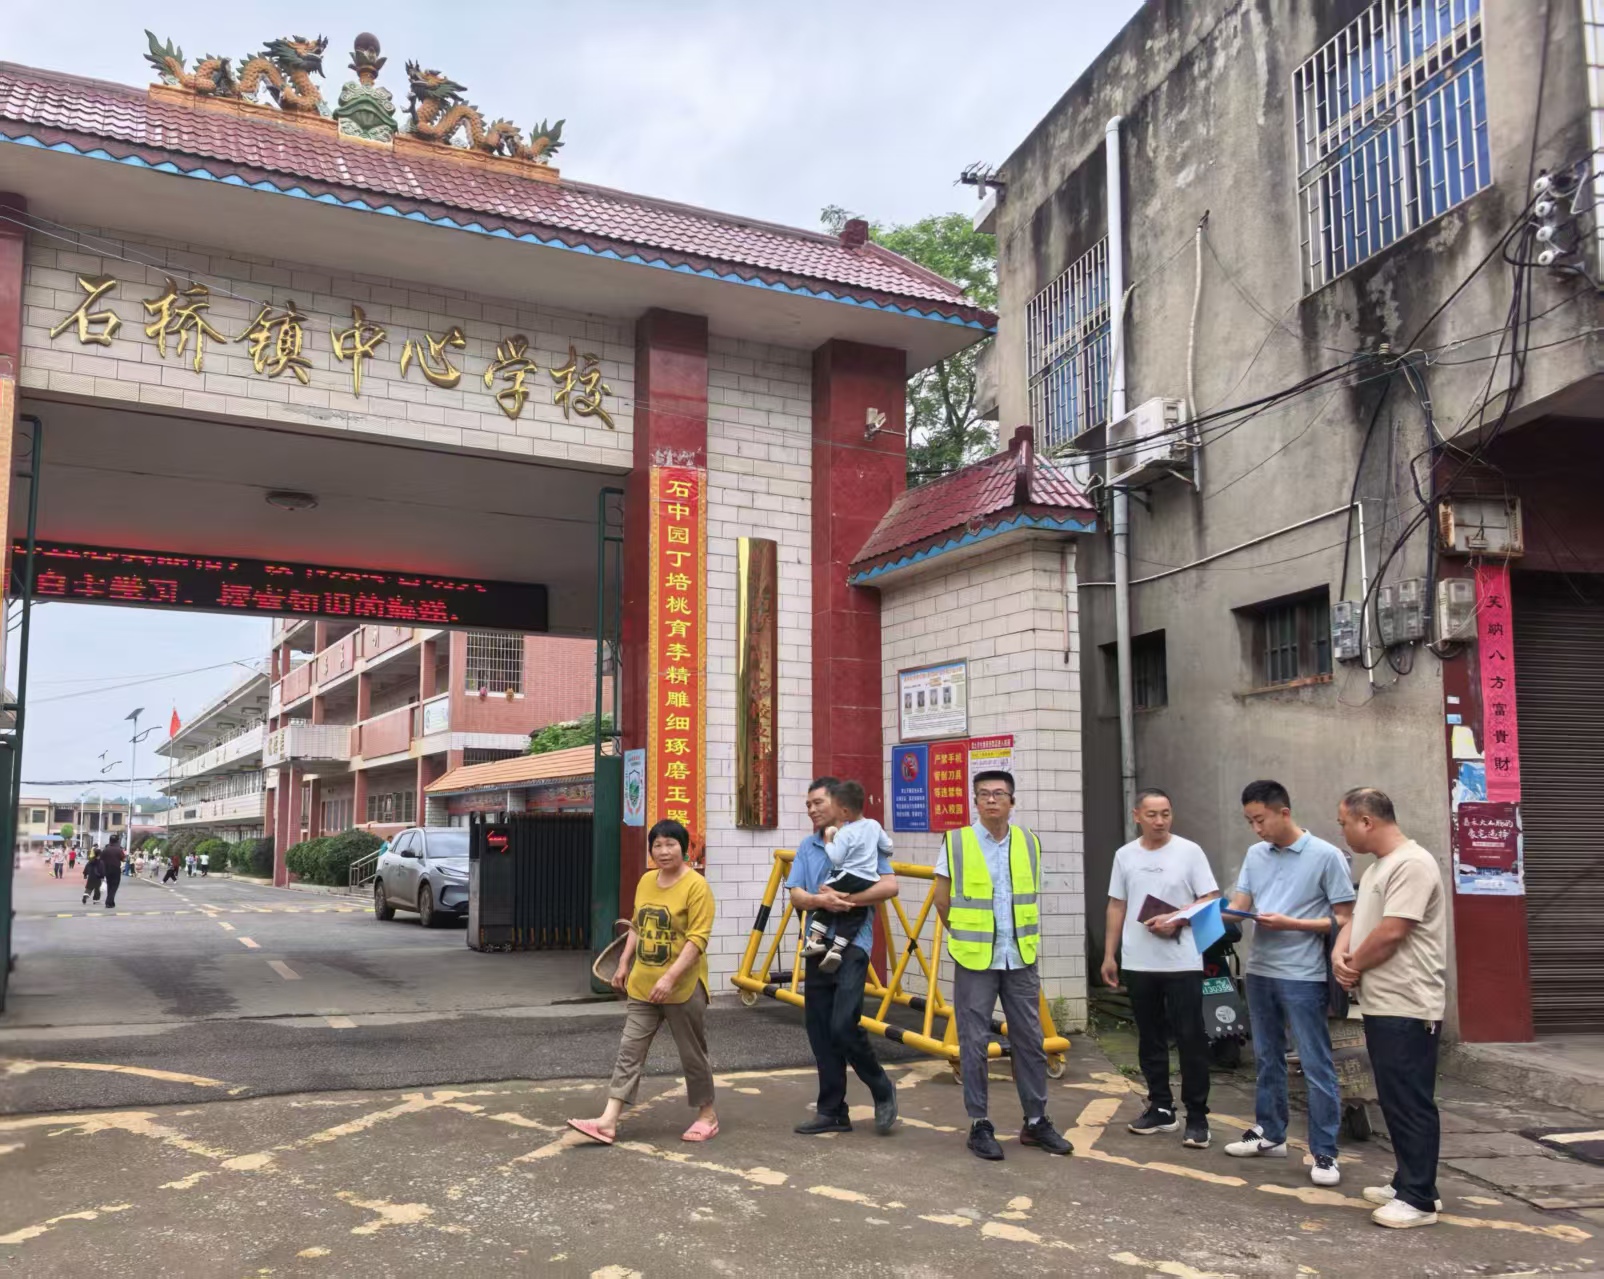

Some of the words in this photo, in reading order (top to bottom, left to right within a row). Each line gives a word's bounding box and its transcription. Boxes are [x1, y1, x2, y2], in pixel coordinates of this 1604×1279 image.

[51, 275, 615, 430] 石桥镇中心学校
